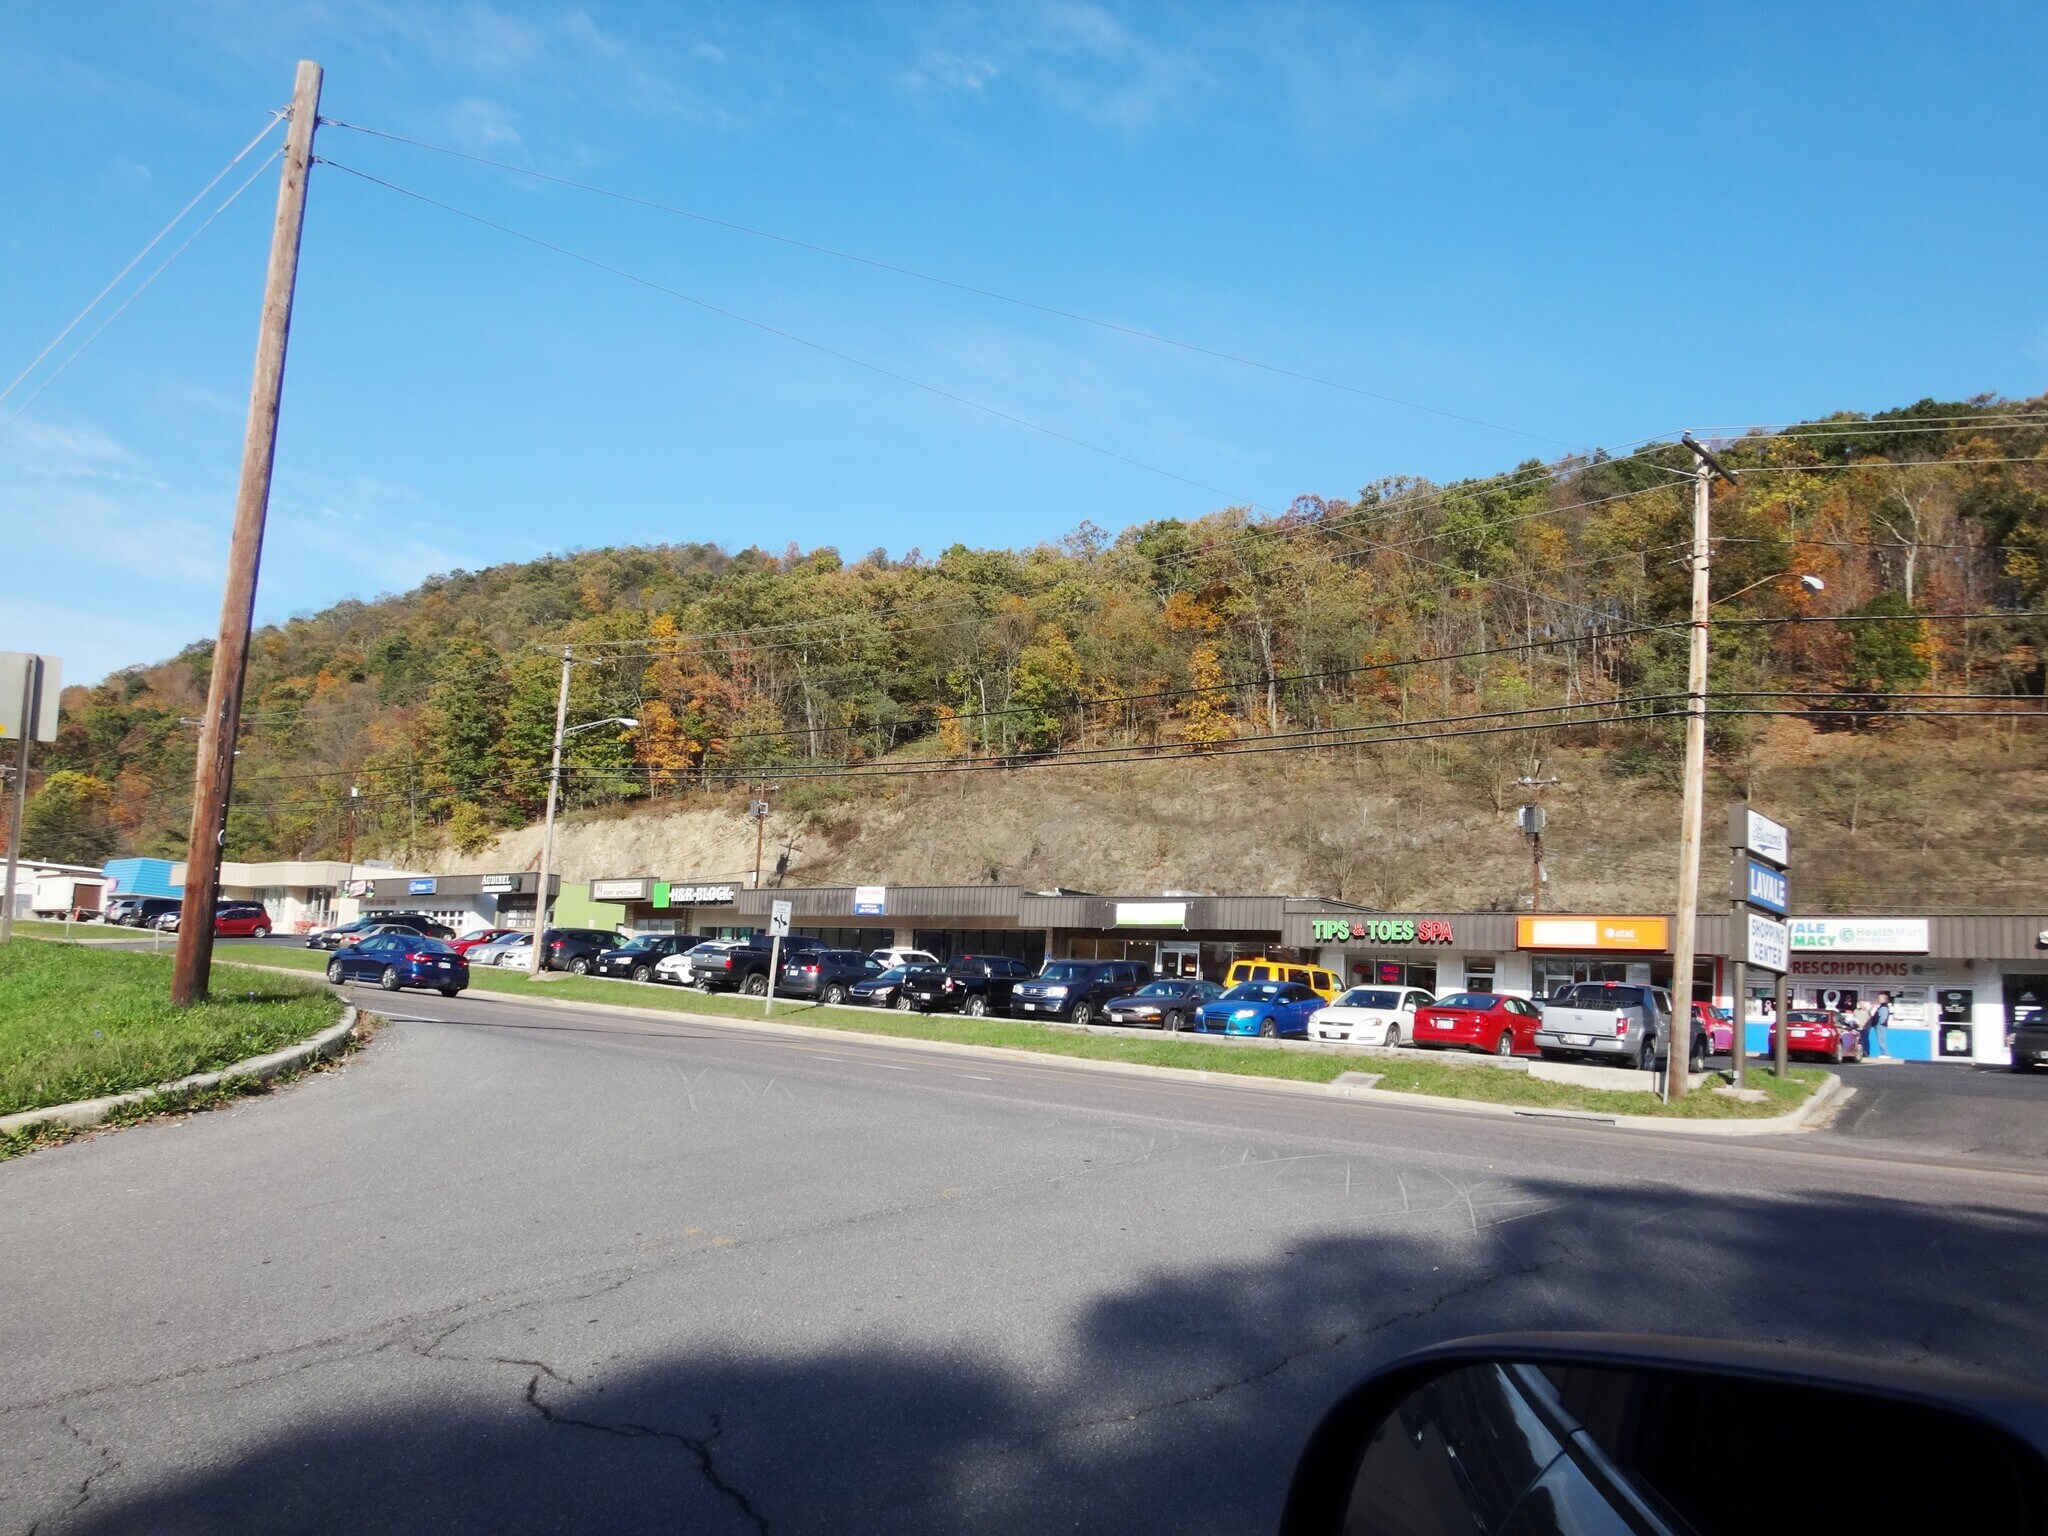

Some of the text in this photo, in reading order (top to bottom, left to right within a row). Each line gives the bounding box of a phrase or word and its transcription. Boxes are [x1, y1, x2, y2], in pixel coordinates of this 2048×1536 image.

[481, 875, 510, 885] AUDIBEL
[1751, 868, 1786, 907] LAVALE
[670, 886, 731, 902] H&R BLOCK
[1312, 920, 1453, 942] TIPS & TOES SPA
[1752, 918, 1785, 945] SHOPPING
[1856, 928, 1895, 937] Health
[1754, 941, 1783, 966] CENTER
